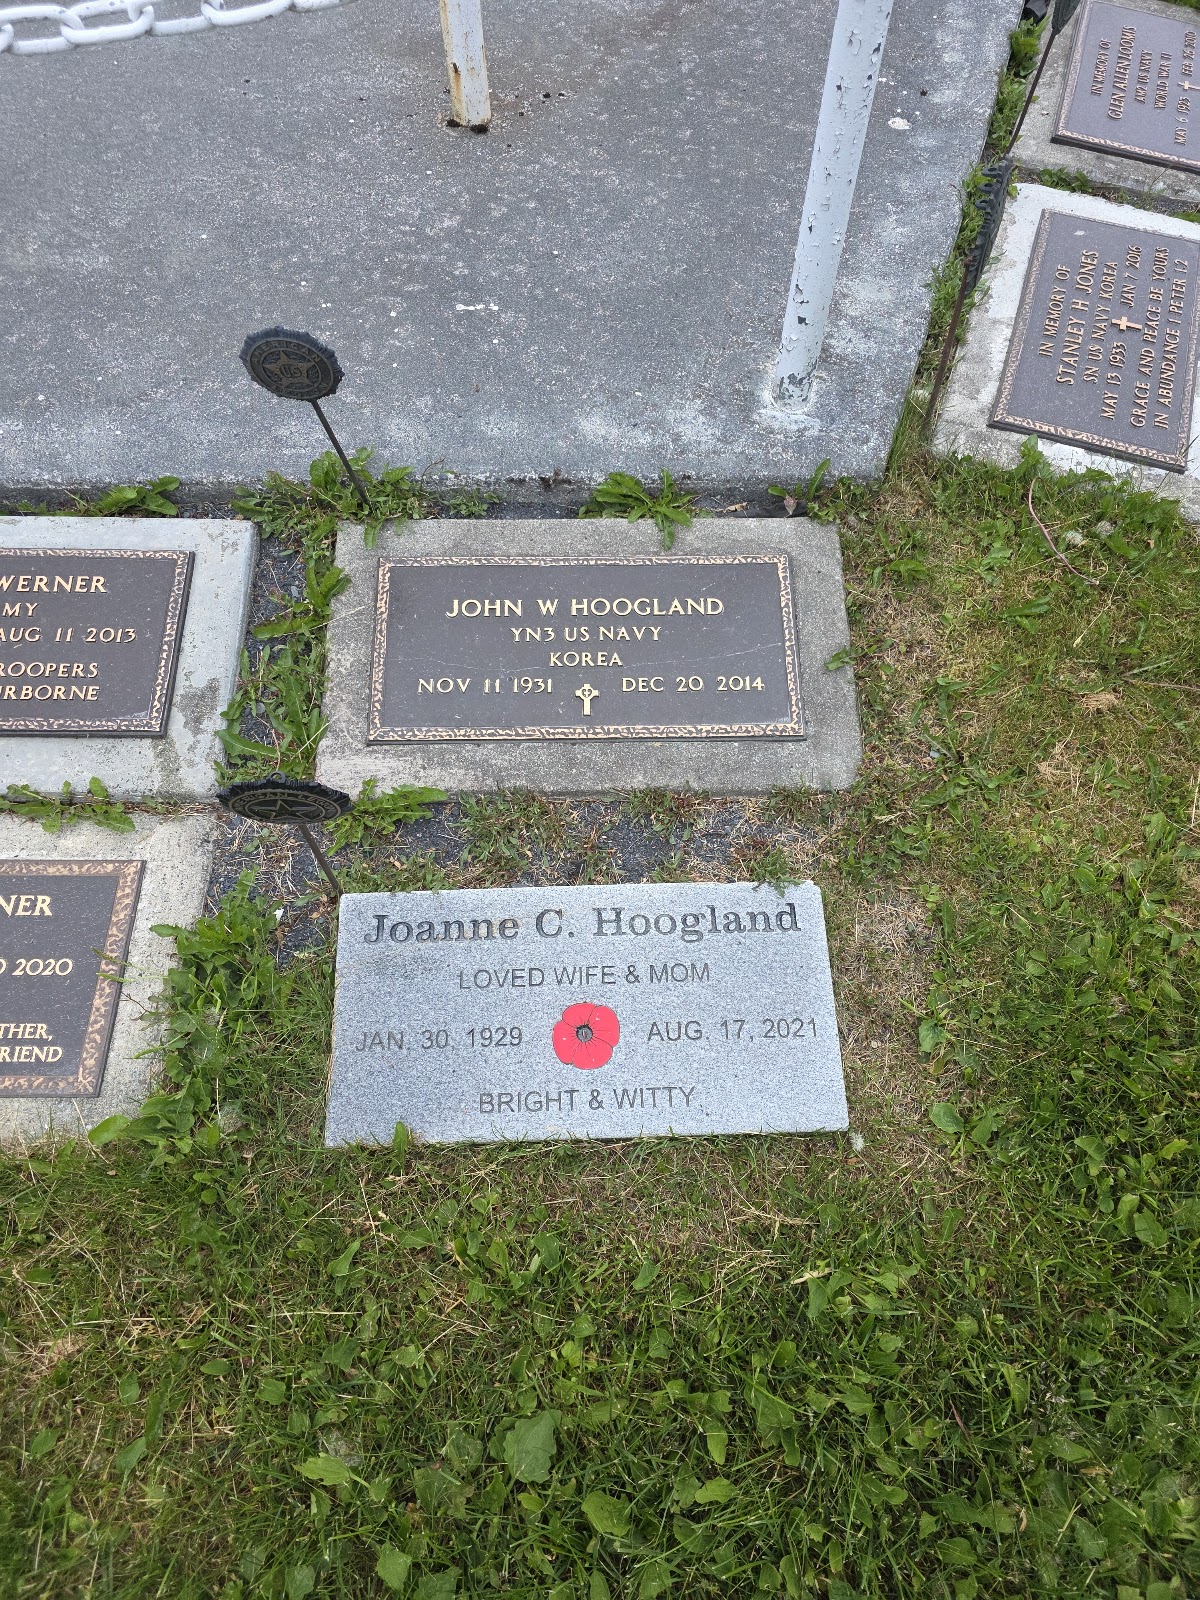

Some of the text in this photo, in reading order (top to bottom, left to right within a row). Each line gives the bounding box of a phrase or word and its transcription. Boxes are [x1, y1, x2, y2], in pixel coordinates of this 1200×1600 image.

[1091, 38, 1111, 96] IN MEMORY OF
[1108, 25, 1136, 120] GLEN ALLEN LOOMIS
[1139, 50, 1152, 72] NAVY
[1137, 73, 1149, 84] US
[1155, 52, 1172, 109] WORLD WAR II
[1174, 127, 1187, 145] MAY
[1126, 245, 1142, 268] 2016
[1120, 284, 1136, 307] JAN
[1169, 278, 1186, 314] PETER
[1039, 264, 1070, 357] IN MEMORY OF
[1056, 250, 1099, 385] STANLEY H JONES
[1084, 262, 1117, 383] SN US NAVY KOREA
[1130, 247, 1169, 427] GRACE AND PEACE BE YOURS
[252, 340, 321, 364] AMERICAN
[282, 364, 301, 377] US
[1158, 328, 1180, 408] ABUNDANCE
[1101, 342, 1126, 419] MAY 13 1933
[1154, 413, 1168, 429] IN
[445, 597, 725, 619] JOHN W HOOGLAND
[54, 628, 73, 643] 11
[85, 628, 137, 643] 2013
[510, 626, 662, 643] YN3 US NAVY
[549, 652, 624, 668] KOREA
[417, 677, 553, 695] NOV 11 1931
[621, 676, 765, 693] DEC 20 2014
[363, 902, 802, 946] Joanne C. Hoogland
[12, 958, 73, 976] 2020
[458, 963, 711, 990] LOVED WIFE & MOM
[356, 1026, 523, 1051] JAN. 30, 1929
[648, 1017, 817, 1042] AUG. 17, 2021
[479, 1085, 696, 1114] BRIGHT & WITTY
